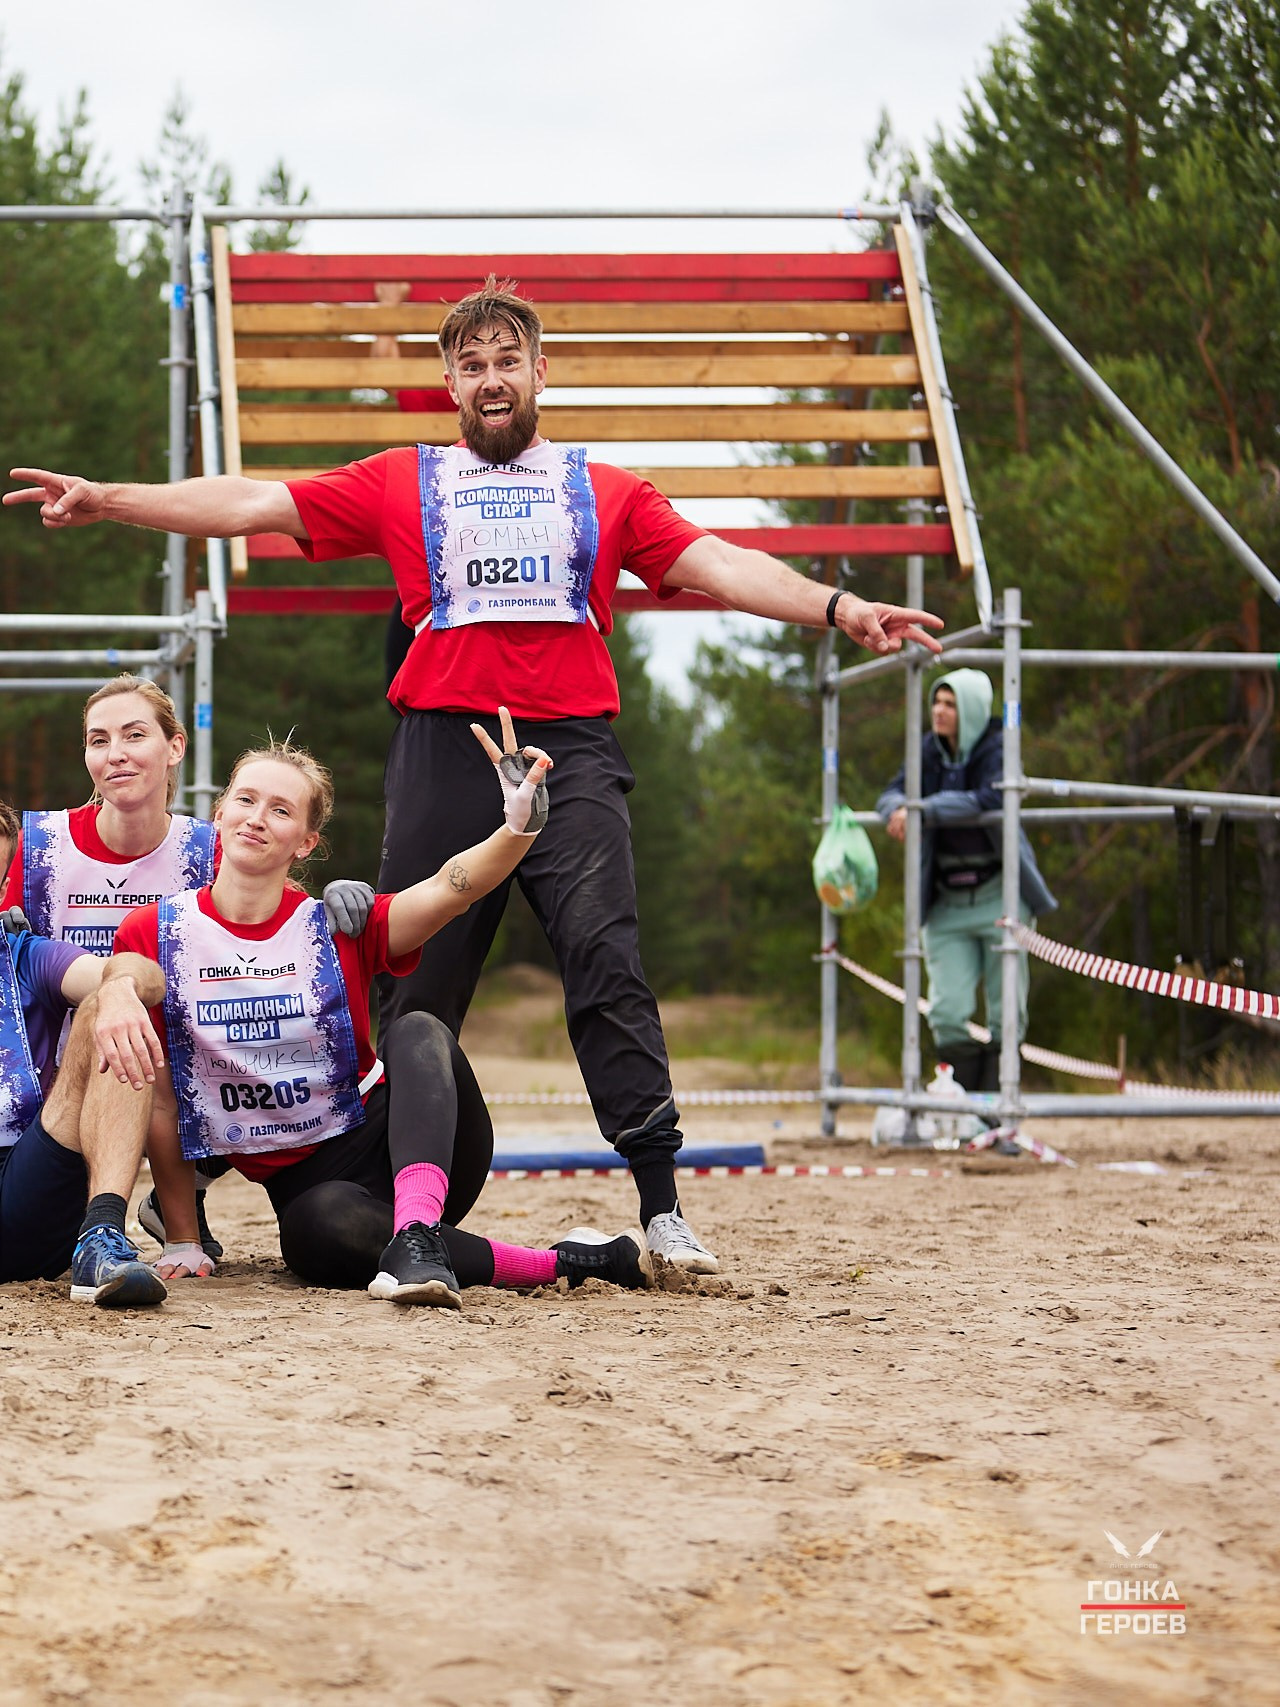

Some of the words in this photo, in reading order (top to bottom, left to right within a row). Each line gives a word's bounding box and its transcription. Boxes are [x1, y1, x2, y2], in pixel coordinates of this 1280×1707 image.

[459, 464, 499, 476] ГОНКА
[456, 488, 553, 506] КОМАНДНЫЙ
[483, 504, 528, 518] СТАРТ
[459, 525, 550, 553] РОМАН
[466, 555, 551, 587] 03201
[488, 598, 557, 608] ГАЗПРОМБАНК
[67, 894, 110, 905] ГОНКА
[199, 965, 241, 979] ГОНКА
[246, 962, 296, 977] ГЕРОЕВ
[200, 993, 302, 1023] КОМАНДНЫЙ
[229, 1020, 276, 1040] СТАРТ
[220, 1077, 311, 1112] 03205
[250, 1115, 323, 1137] ГАЗПРОМБАНК
